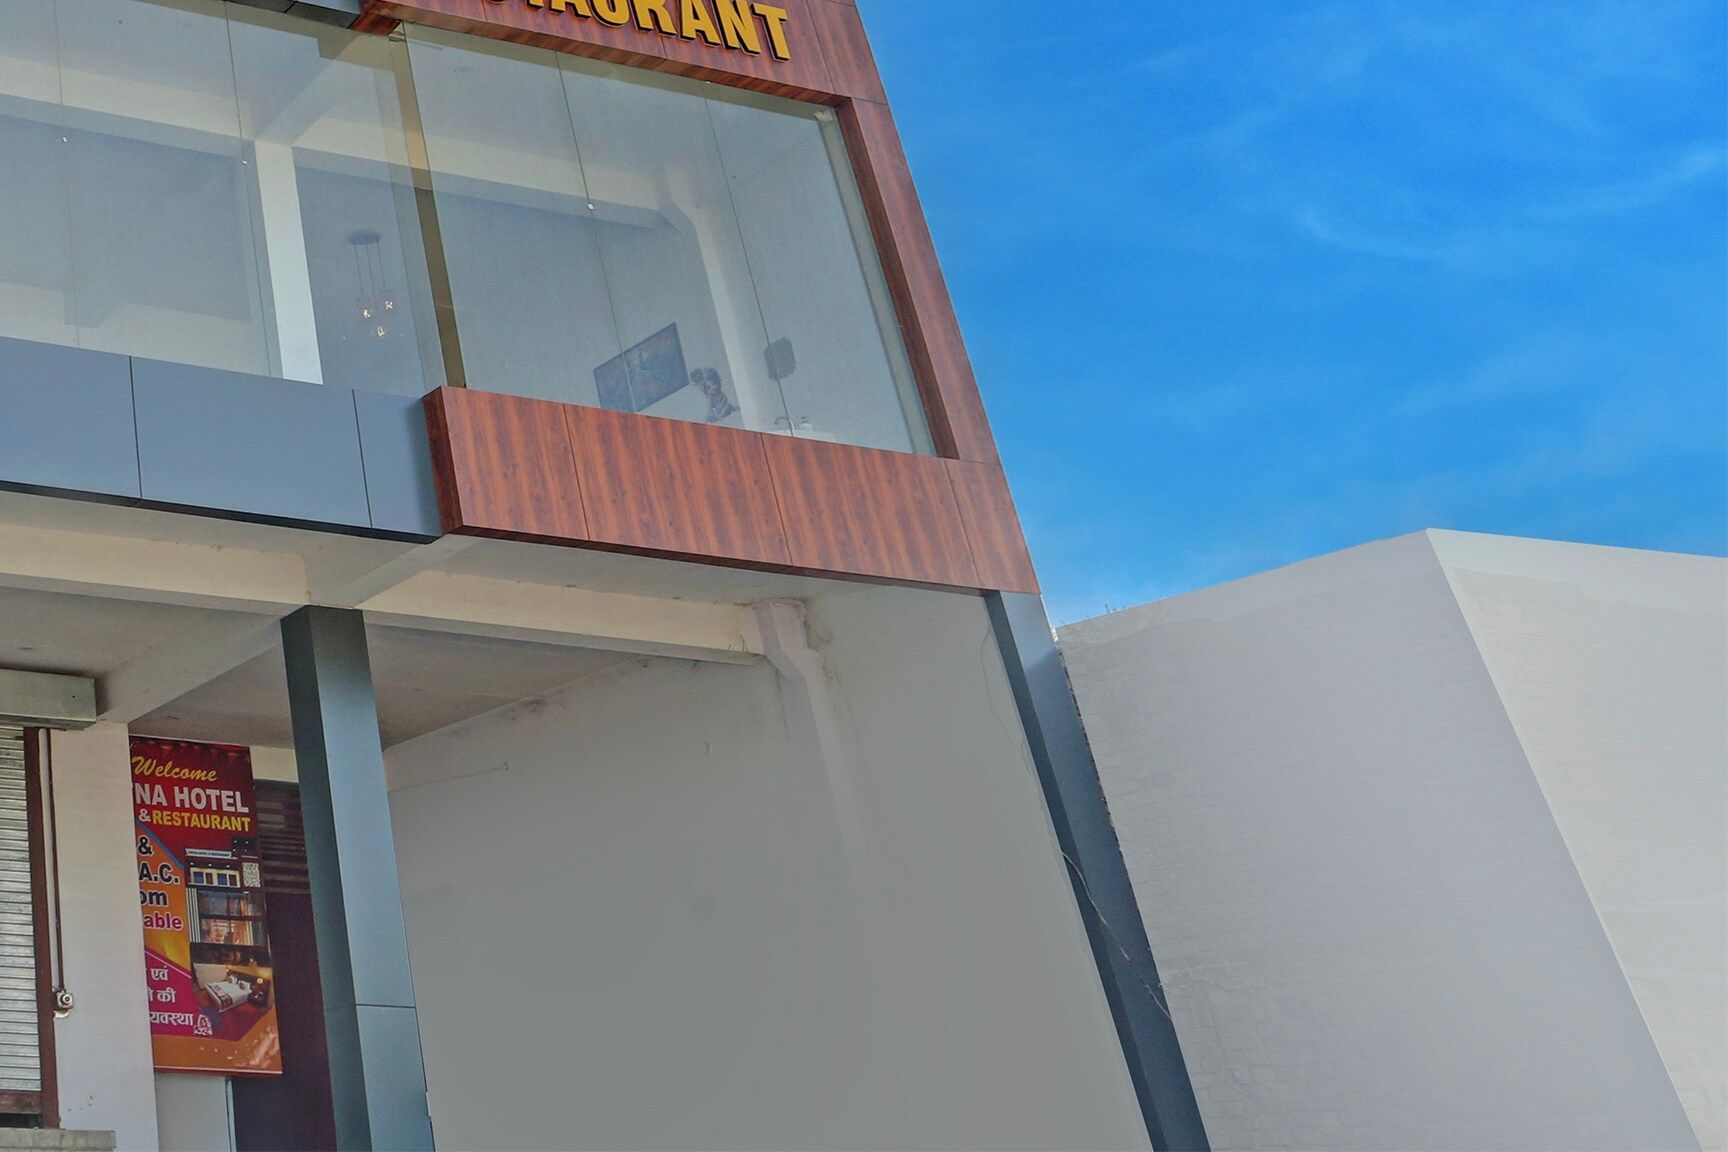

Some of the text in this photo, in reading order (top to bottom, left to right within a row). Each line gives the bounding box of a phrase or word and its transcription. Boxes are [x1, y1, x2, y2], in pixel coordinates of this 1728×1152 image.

[131, 756, 218, 782] Welcome
[133, 782, 250, 814] NA HOTEL
[138, 808, 251, 832] & RESTAURANT
[138, 835, 154, 856] &
[139, 861, 181, 884] A.C.
[143, 912, 183, 930] able
[150, 965, 169, 981] एवं
[157, 987, 176, 1003] की
